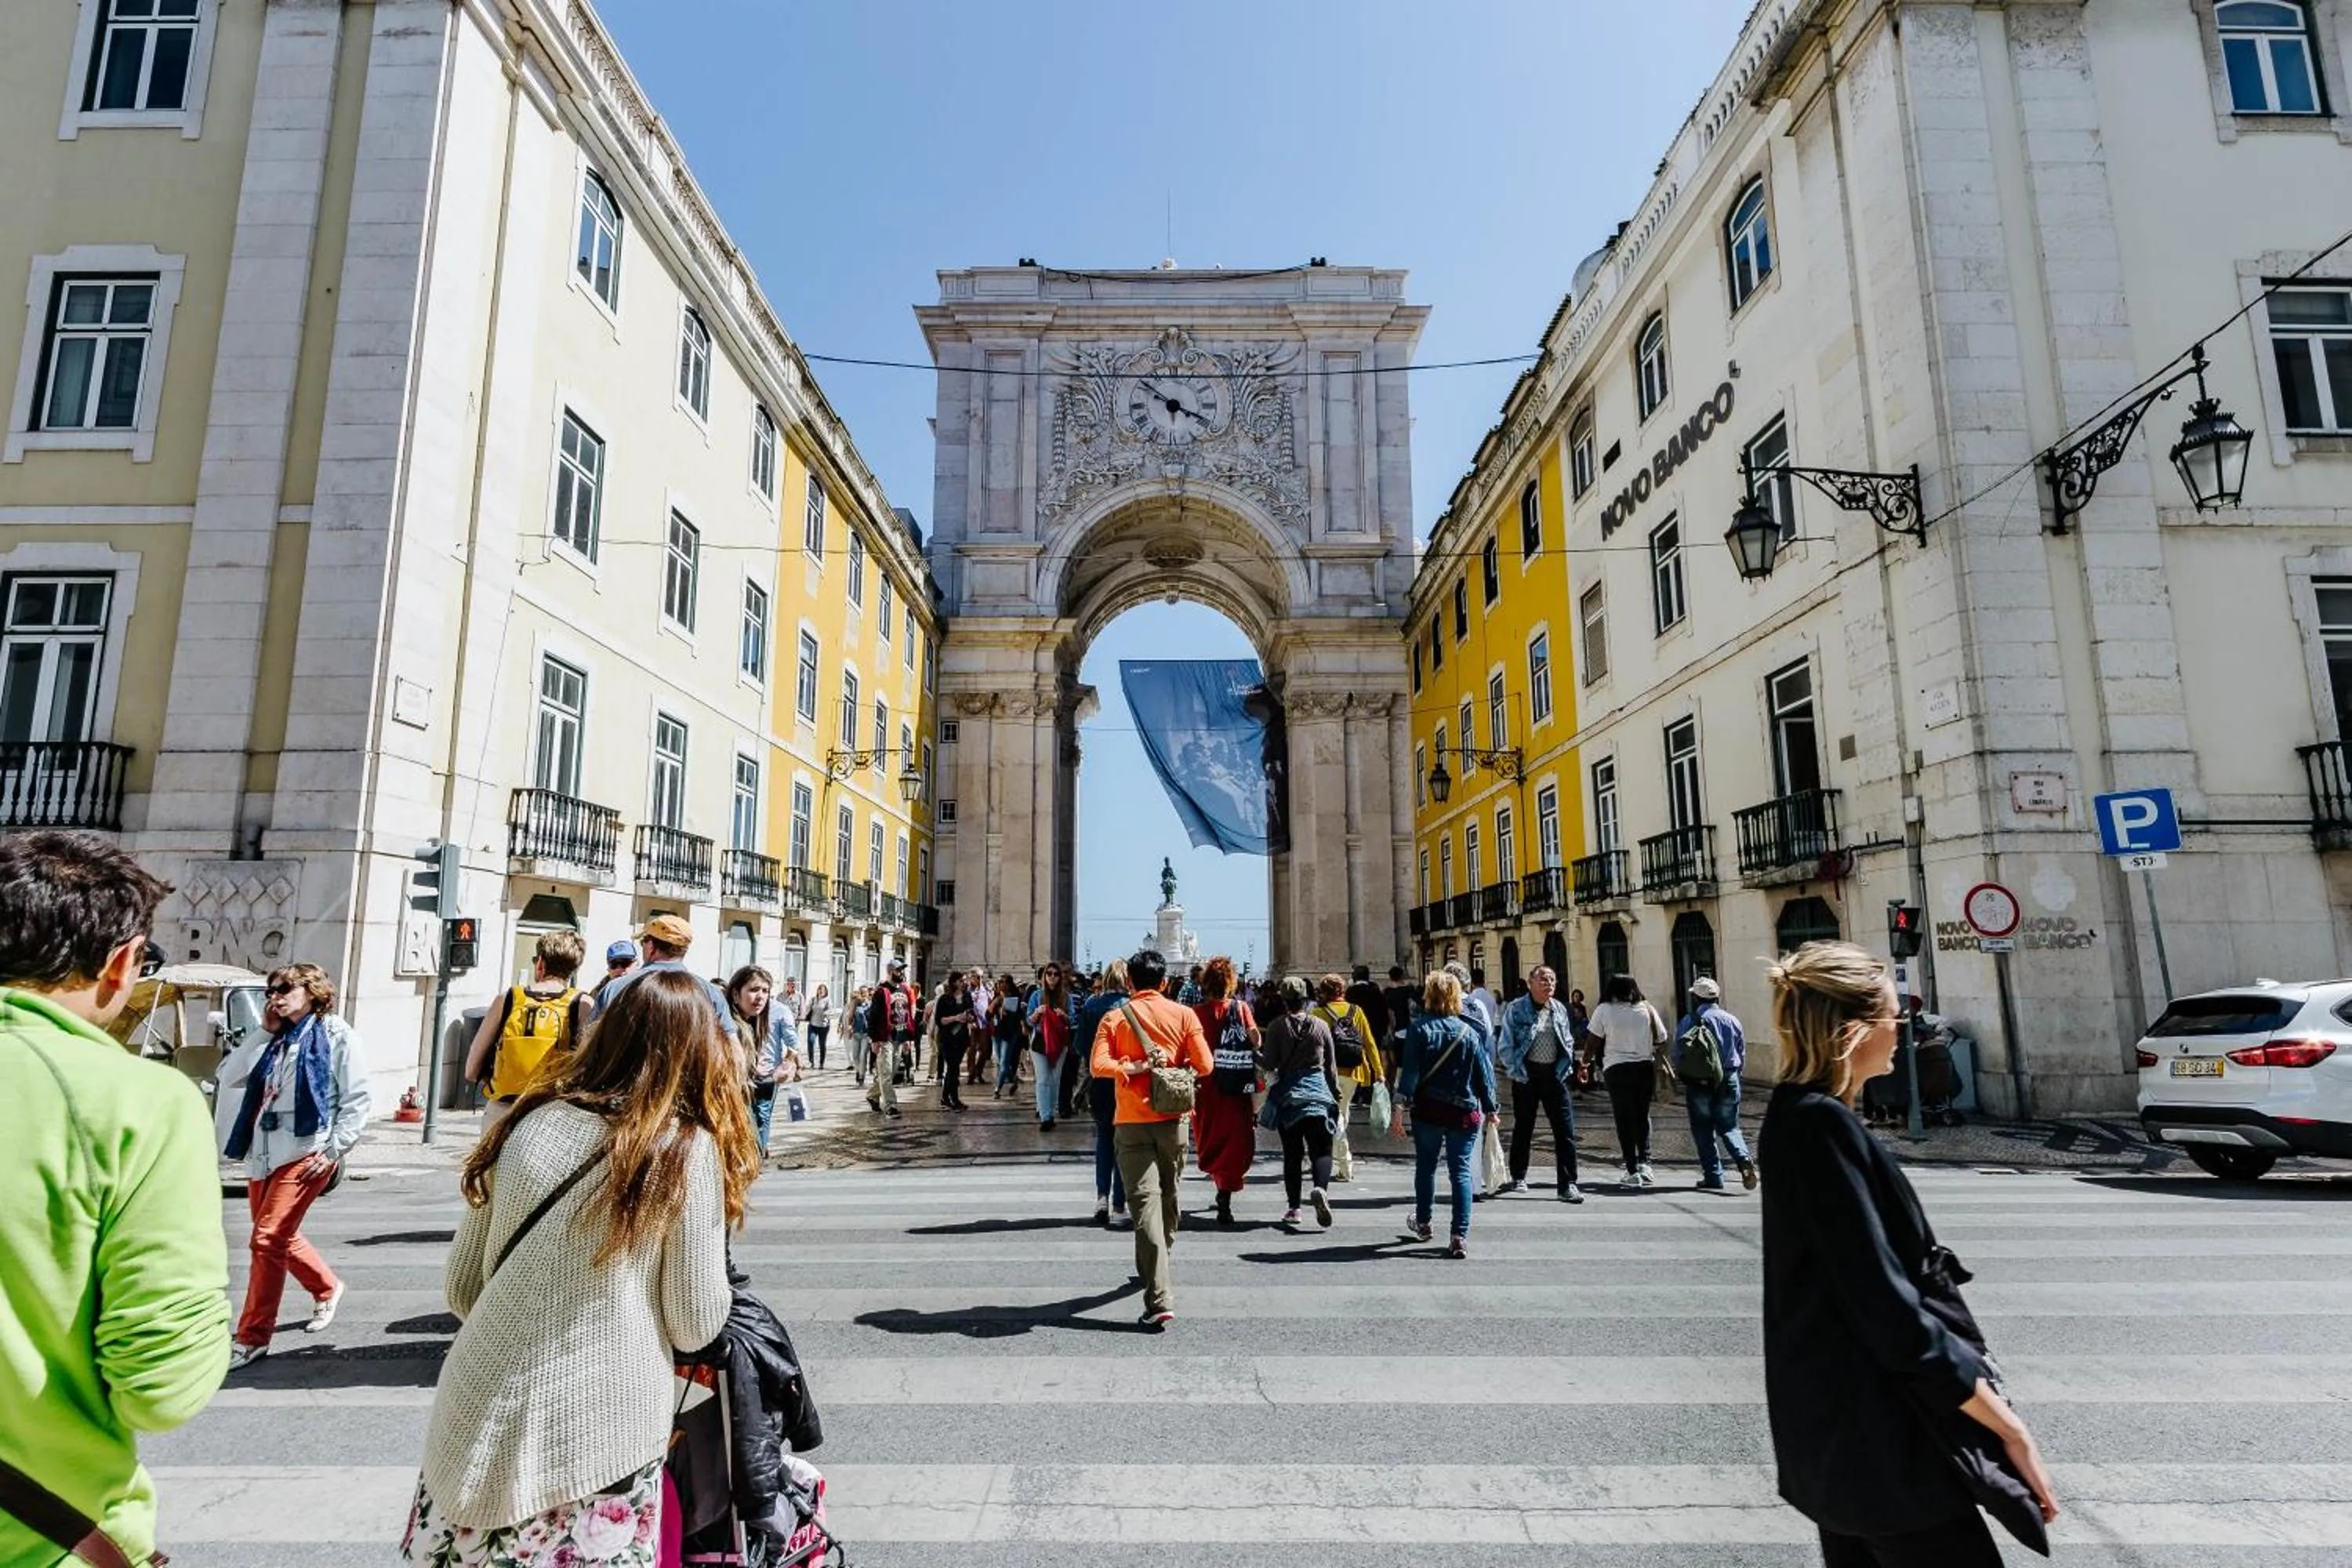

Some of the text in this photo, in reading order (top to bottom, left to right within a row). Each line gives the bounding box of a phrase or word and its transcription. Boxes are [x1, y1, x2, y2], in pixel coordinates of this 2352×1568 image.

[1600, 382, 1735, 542] NOVO BANCO
[2110, 797, 2158, 848] P
[1936, 920, 1972, 935] NOVO
[1937, 935, 1980, 951] BANCO
